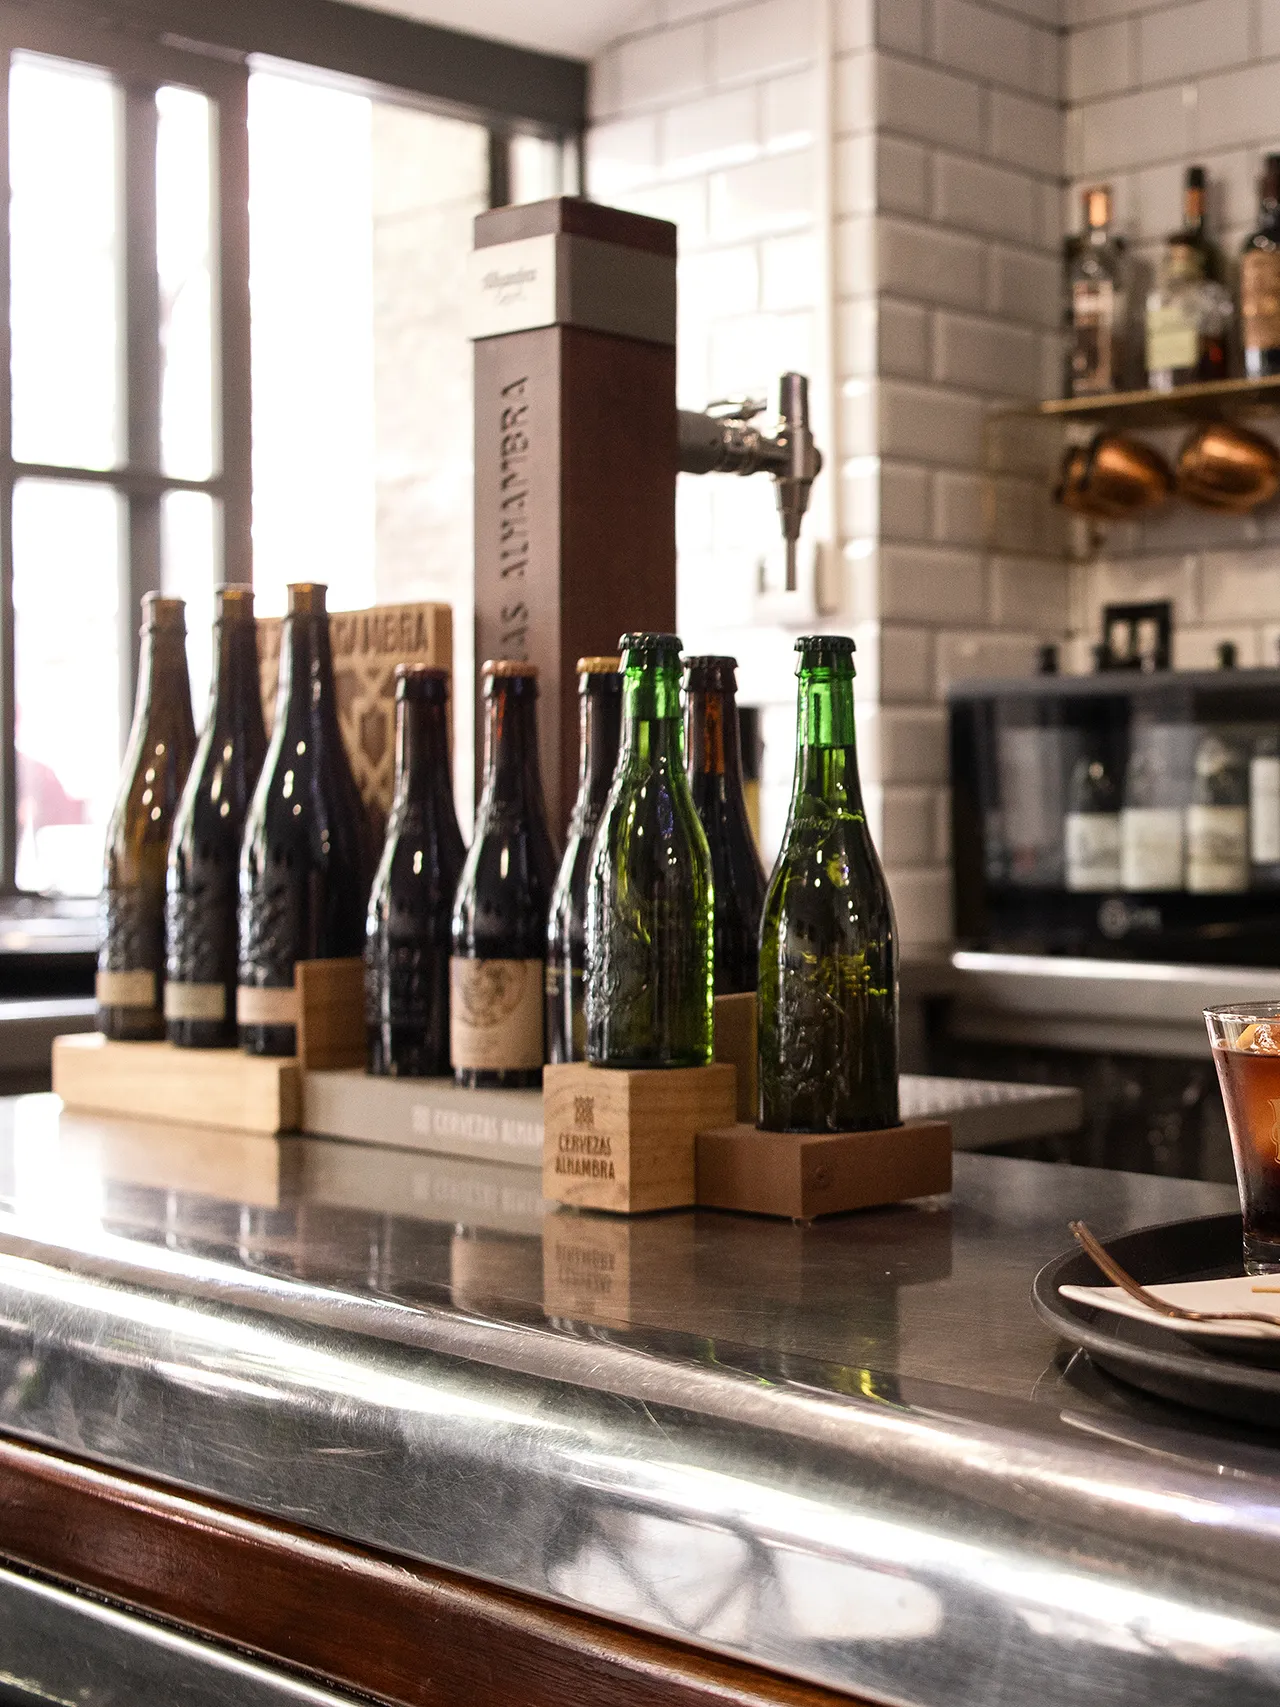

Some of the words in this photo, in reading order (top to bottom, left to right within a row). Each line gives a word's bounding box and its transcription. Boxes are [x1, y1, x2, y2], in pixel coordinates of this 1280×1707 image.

[501, 376, 529, 578] ALHAMBRA
[501, 602, 529, 661] AS
[558, 1132, 613, 1157] CERVEZAS
[555, 1156, 616, 1180] ALHAMBRA
